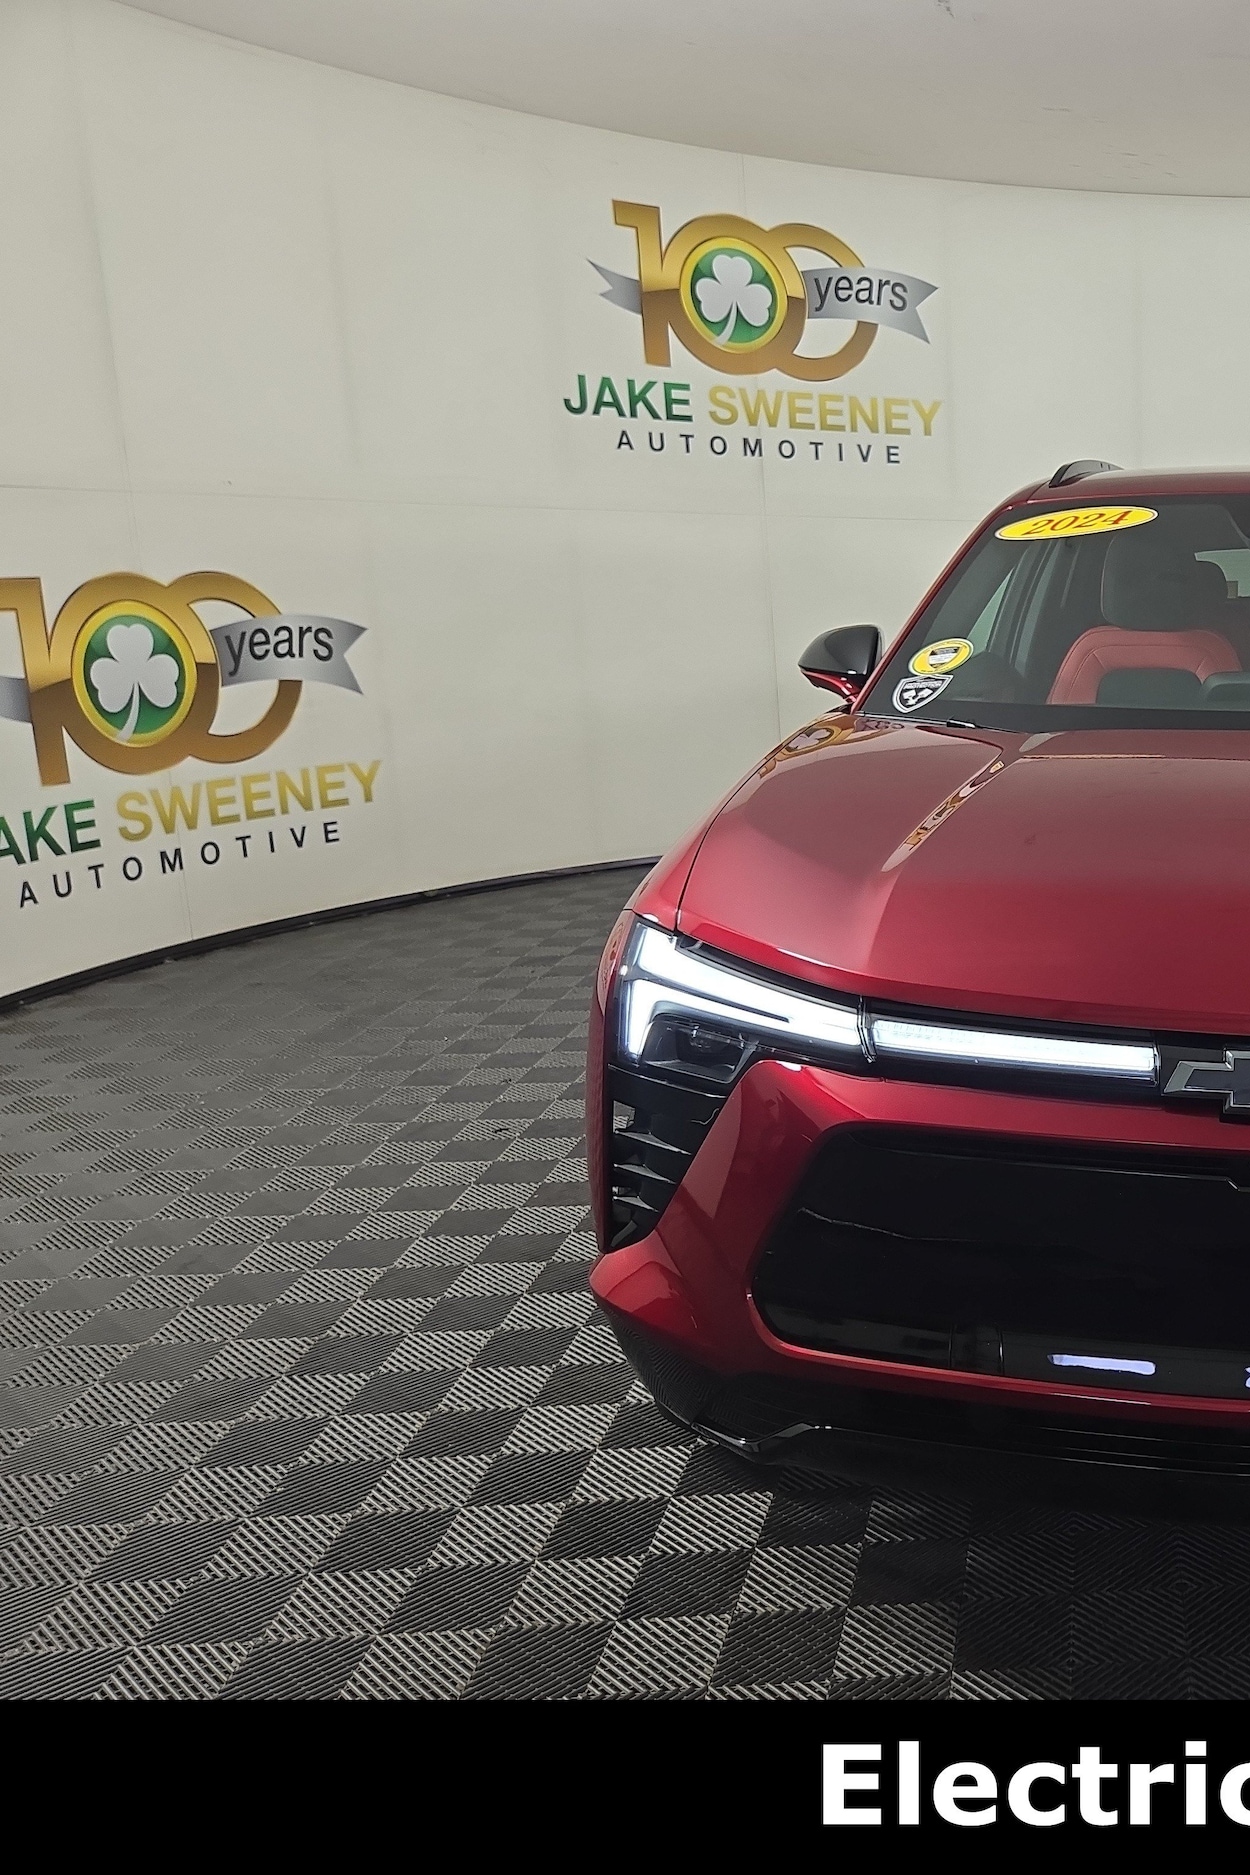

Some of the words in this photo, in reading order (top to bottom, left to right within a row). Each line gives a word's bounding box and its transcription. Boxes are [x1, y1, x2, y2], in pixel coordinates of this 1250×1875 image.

[814, 273, 909, 312] years
[564, 374, 694, 423] JAKE
[709, 385, 942, 436] SWEENEY
[617, 430, 901, 464] AUTOMOTIVE
[1021, 509, 1132, 536] 2024
[225, 624, 334, 677] years
[116, 760, 382, 842] SWEENEY
[19, 821, 341, 908] AUTOMOTIVE
